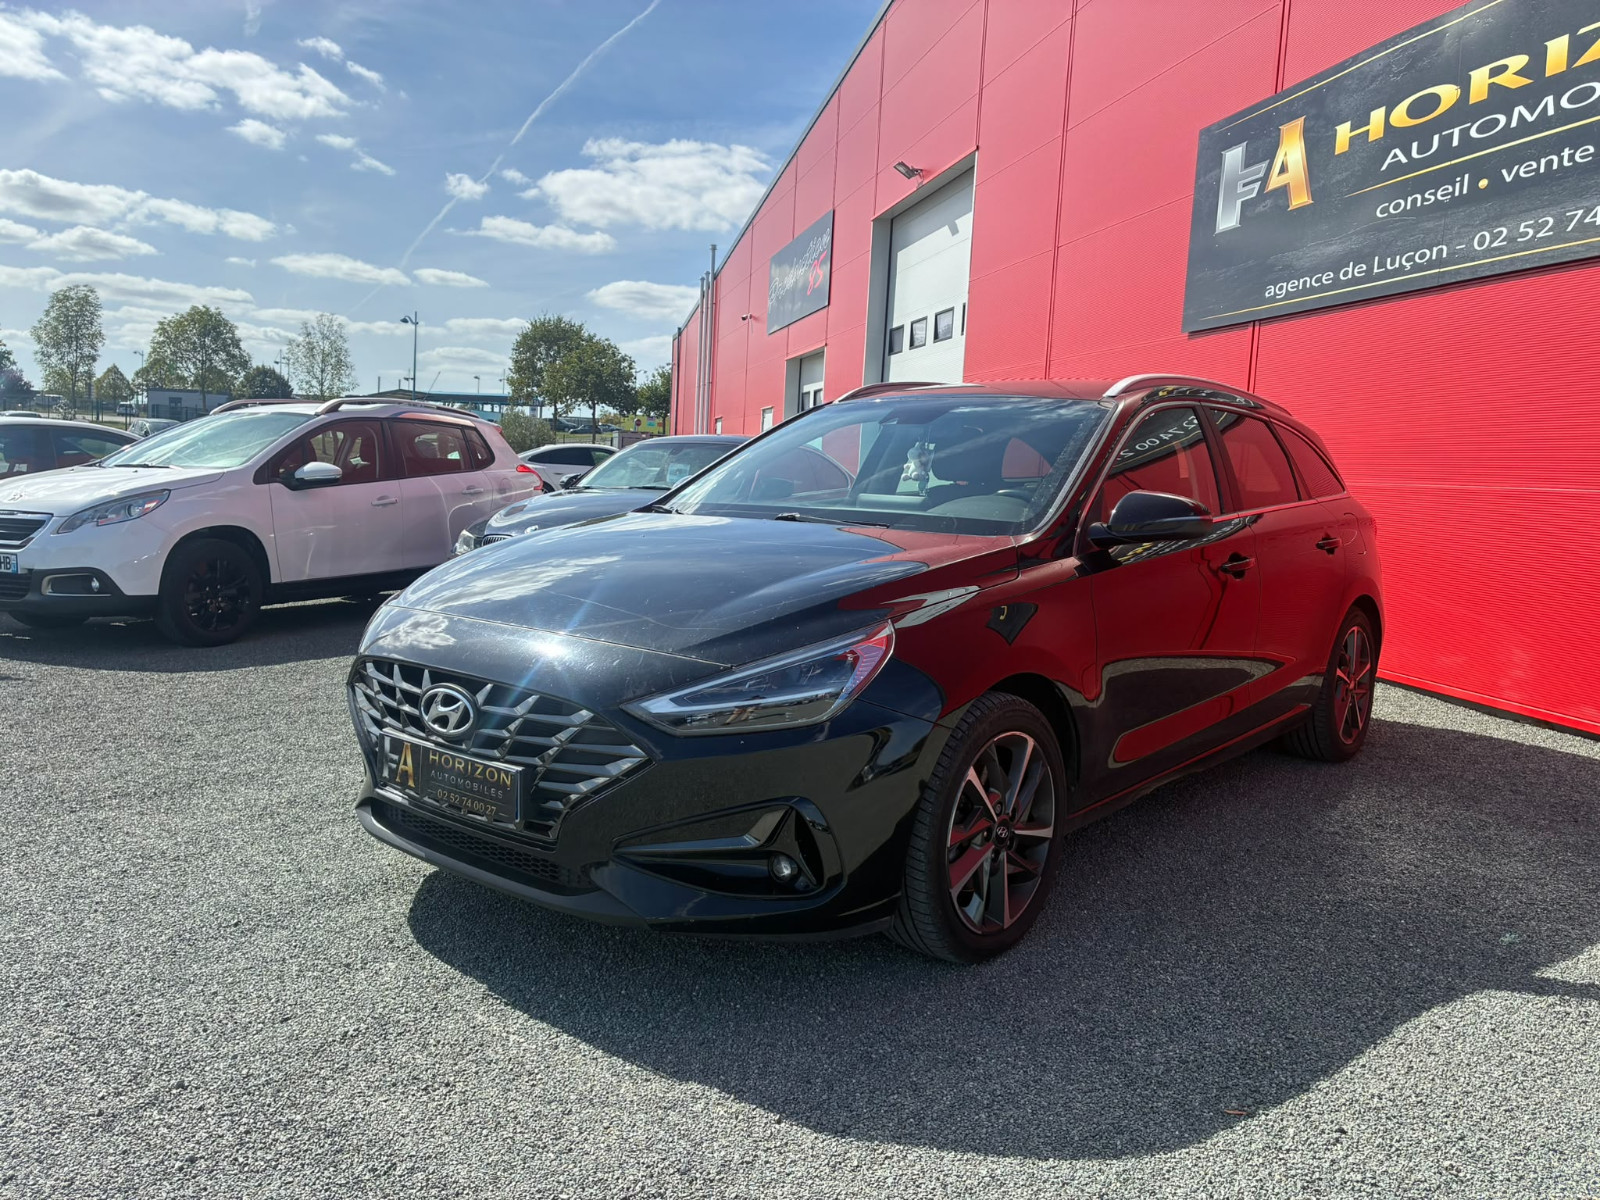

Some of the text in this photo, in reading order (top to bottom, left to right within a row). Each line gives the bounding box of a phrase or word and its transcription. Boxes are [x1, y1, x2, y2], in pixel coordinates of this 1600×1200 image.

[1375, 144, 1595, 218] conseil vente
[1264, 271, 1333, 299] agence
[1339, 261, 1367, 281] de
[1373, 245, 1447, 276] Luçon
[1473, 227, 1508, 251] 02
[1516, 216, 1554, 242] 52
[1566, 205, 1600, 232] 74
[429, 750, 513, 788] HORIZON
[430, 770, 503, 798] AUTOMOBILES
[437, 789, 497, 815] 02 52 74 00 27
